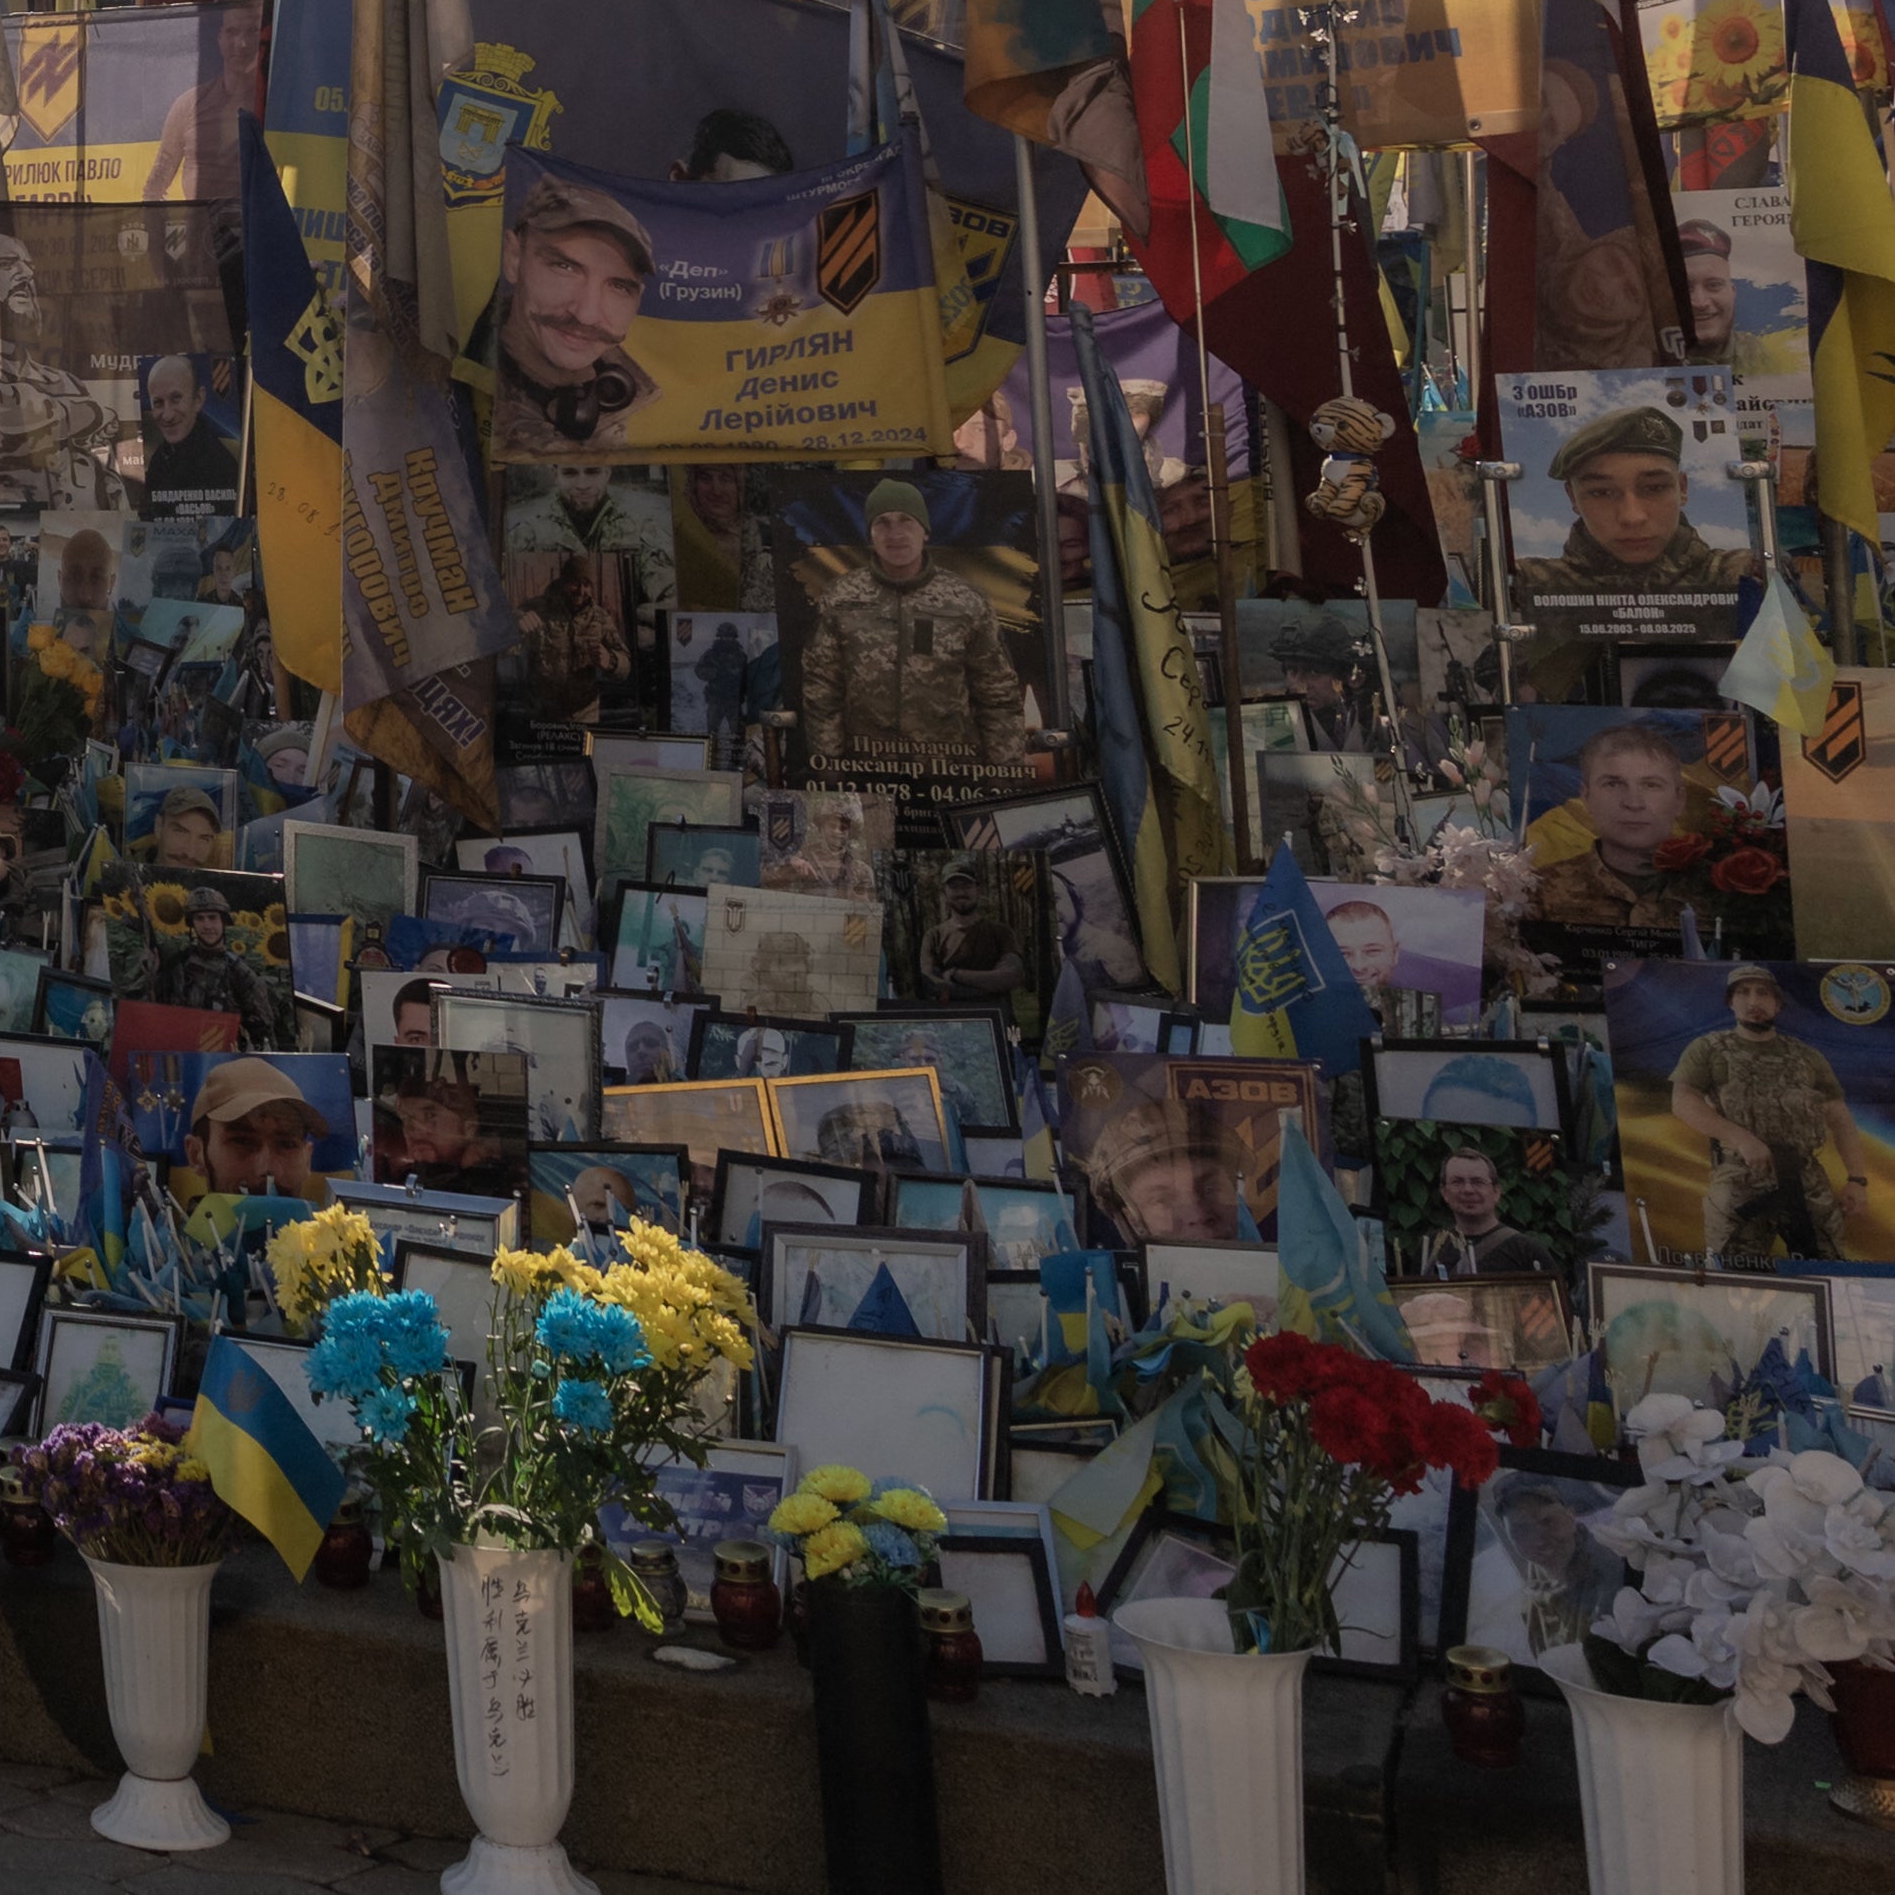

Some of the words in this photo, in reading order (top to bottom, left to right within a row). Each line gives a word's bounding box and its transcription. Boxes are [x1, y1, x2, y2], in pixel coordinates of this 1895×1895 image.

[65, 157, 121, 183] ПАВЛО
[1734, 195, 1792, 211] СЛАВА
[1731, 213, 1792, 227] ГЕРОЯ
[659, 260, 729, 279] «Деп»
[659, 281, 743, 302] (Грузин)
[726, 329, 854, 373] ГИРЛЯН
[735, 369, 839, 403] Денис
[1527, 383, 1578, 402] ОШБр
[699, 397, 878, 434] Лерійович
[1517, 403, 1577, 419] «АЗОВ»
[802, 426, 929, 451] 28.12.2024
[151, 488, 204, 503] БОНДАРЕНКО
[404, 446, 479, 616] Кручман
[1532, 593, 1594, 609] ВОЛОШИН
[1595, 593, 1635, 609] НІКІТА
[1611, 606, 1665, 621] «БАЛОН»
[537, 730, 581, 743] (РЕЛАКС)
[852, 734, 978, 759] Приймачок
[809, 753, 925, 778] Олександр
[932, 758, 1038, 782] Петрович
[1186, 1078, 1298, 1104] АЗОВ
